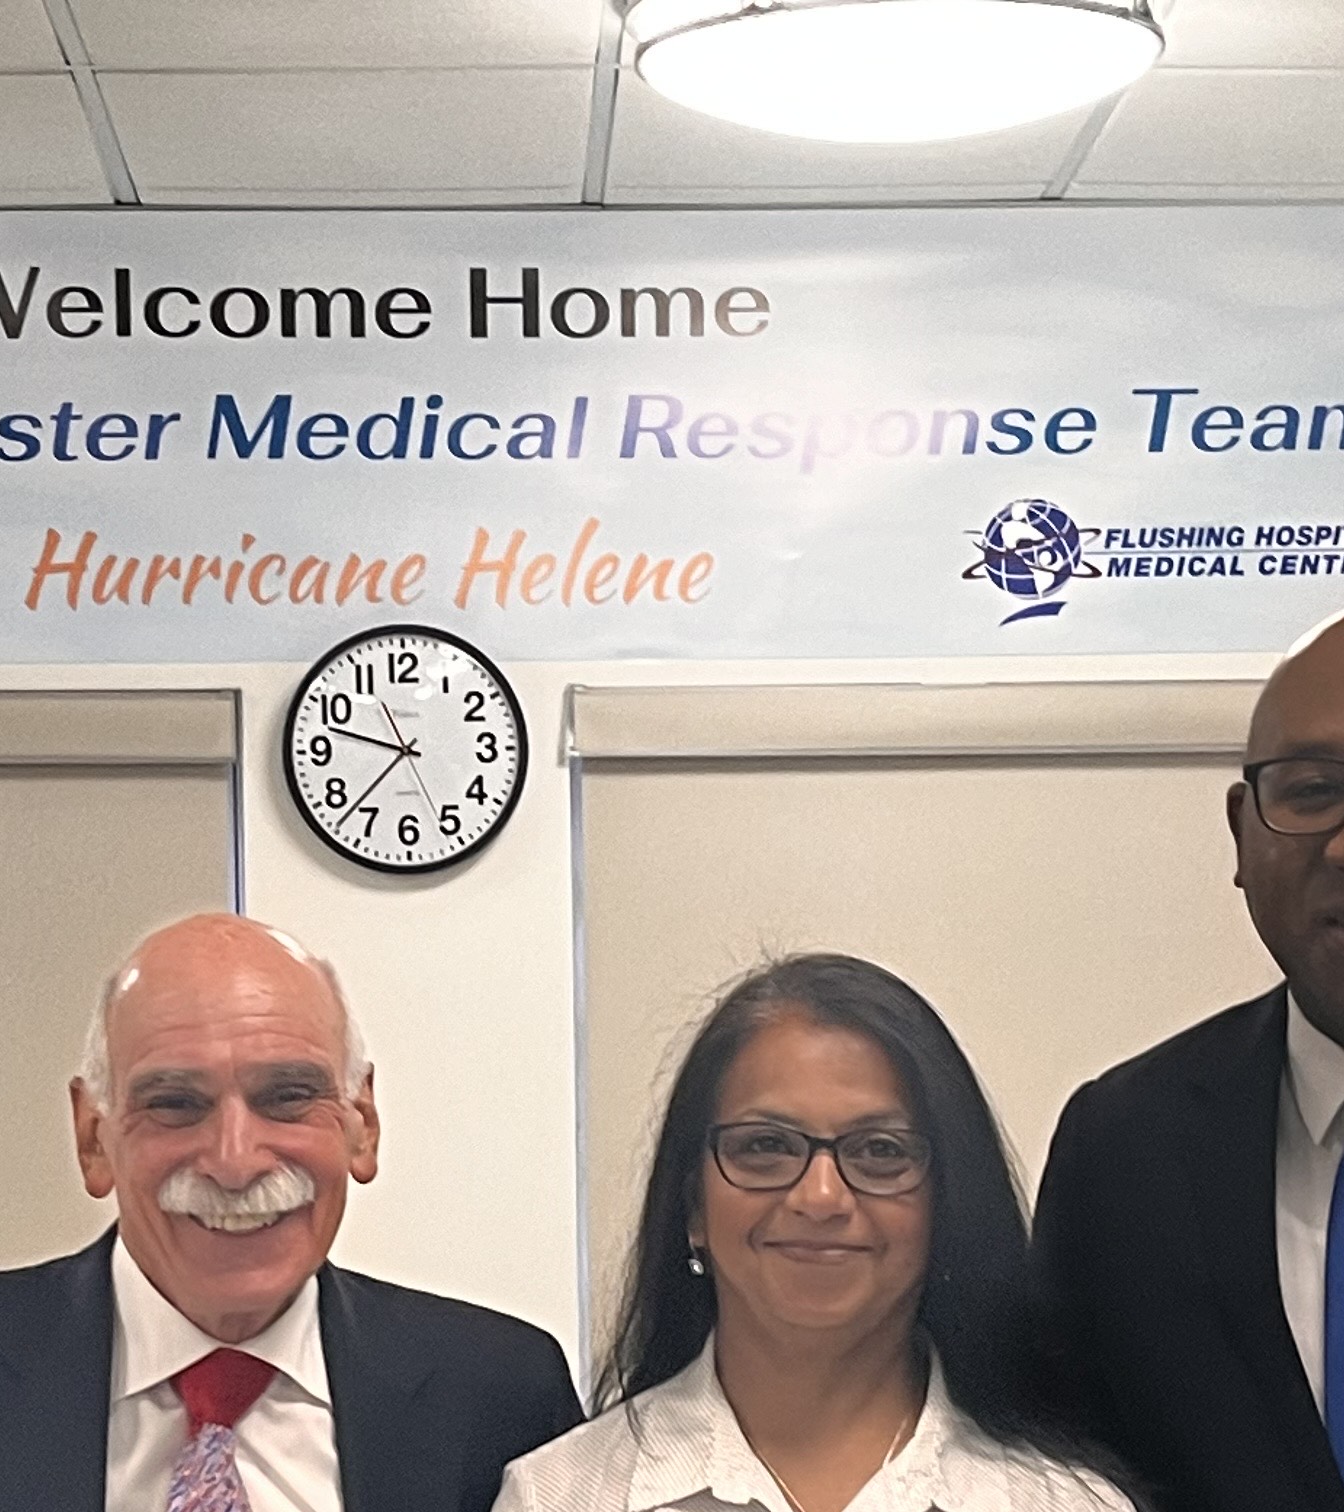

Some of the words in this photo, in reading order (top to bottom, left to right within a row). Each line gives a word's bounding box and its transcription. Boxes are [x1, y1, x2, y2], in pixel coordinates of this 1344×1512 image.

[468, 268, 770, 339] Home
[207, 394, 588, 460] Medical
[619, 394, 1098, 475] Response
[1104, 526, 1251, 553] FLUSHING
[24, 528, 425, 611] Hurricane
[453, 517, 713, 611] Helene
[1107, 556, 1244, 577] MEDICAL
[355, 664, 373, 695] 11
[389, 653, 419, 683] 12
[321, 693, 351, 725] 10
[464, 691, 485, 722] 2
[310, 736, 332, 766] 9
[476, 732, 498, 763] 3
[325, 778, 347, 809] 8
[466, 775, 488, 805] 4
[359, 807, 379, 837] 7
[398, 815, 419, 846] 6
[439, 805, 461, 836] 5
